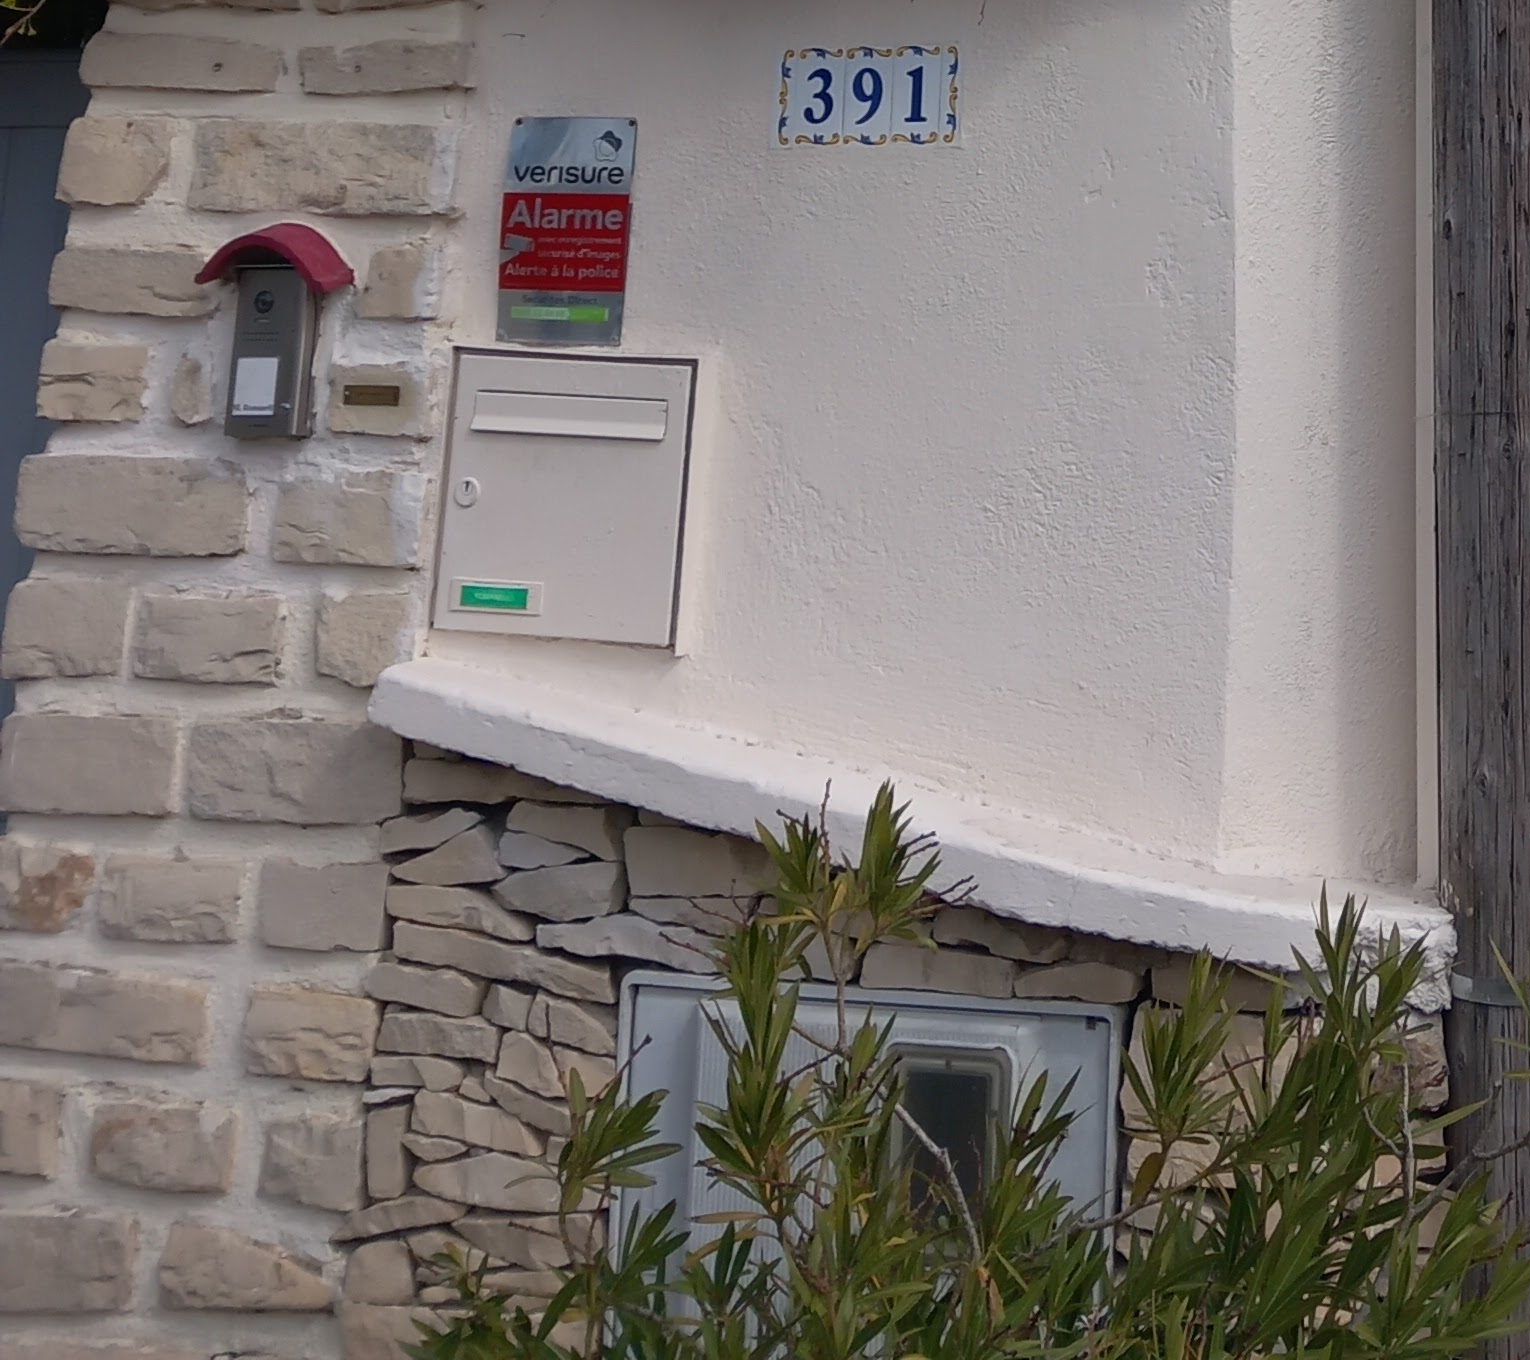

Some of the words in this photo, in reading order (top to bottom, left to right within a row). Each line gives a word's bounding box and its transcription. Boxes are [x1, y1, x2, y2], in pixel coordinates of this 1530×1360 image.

[803, 65, 928, 125] 391
[514, 165, 625, 184] verisure
[507, 198, 624, 230] Alarme
[505, 263, 547, 276] Alerte
[562, 264, 575, 277] la
[578, 264, 619, 280] police
